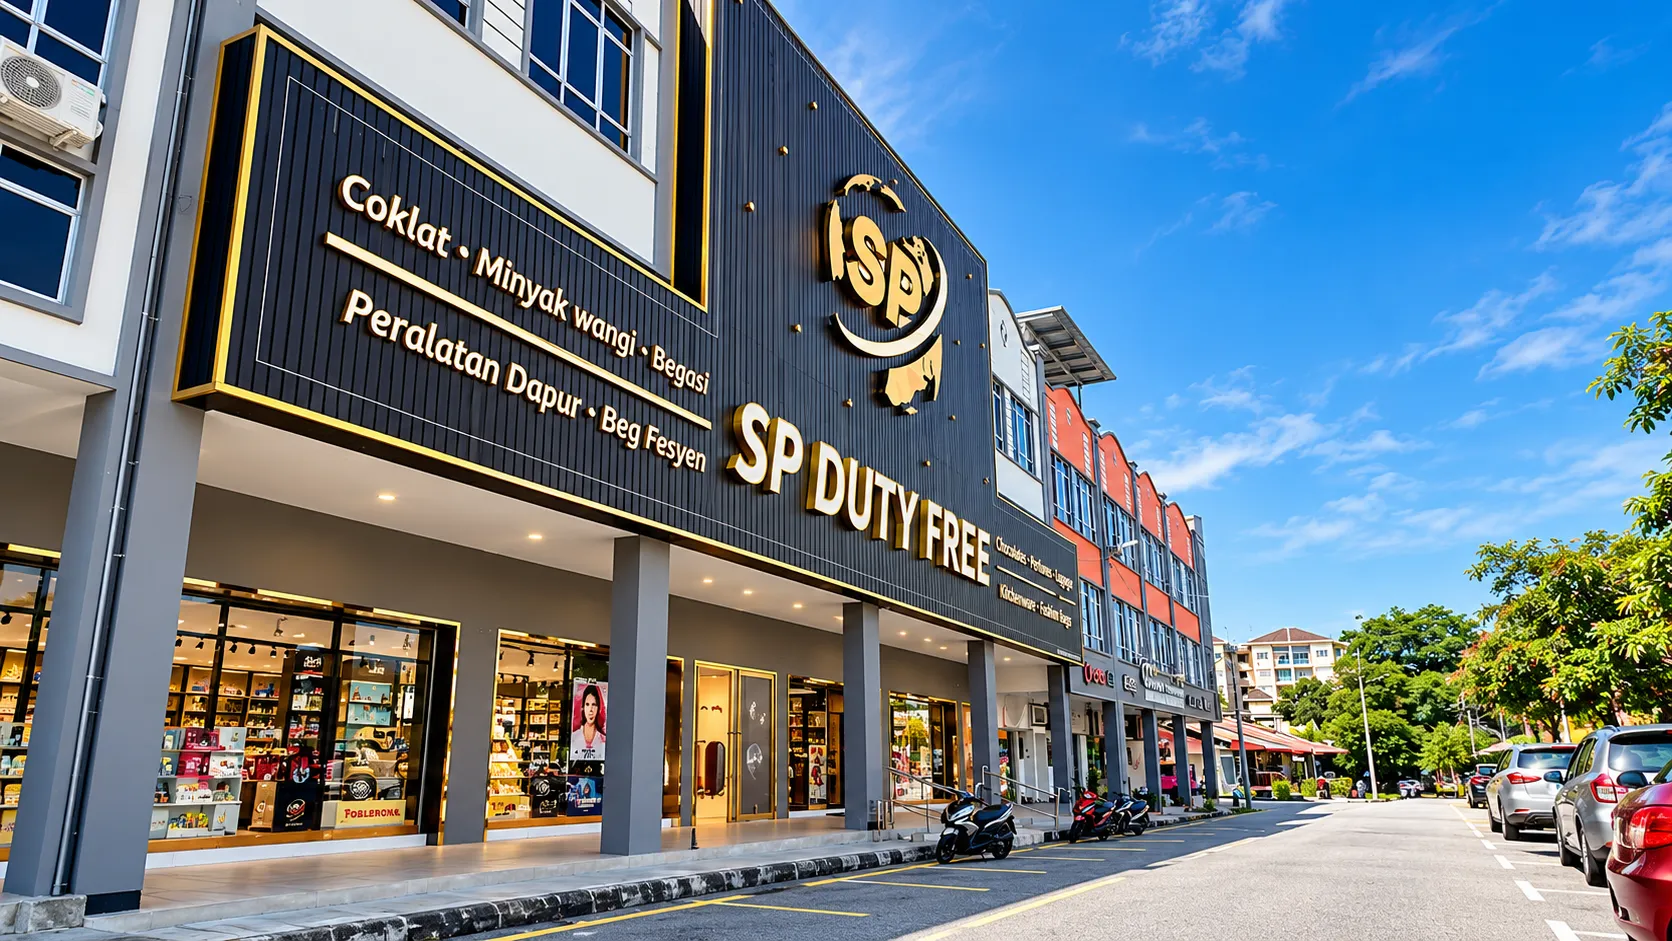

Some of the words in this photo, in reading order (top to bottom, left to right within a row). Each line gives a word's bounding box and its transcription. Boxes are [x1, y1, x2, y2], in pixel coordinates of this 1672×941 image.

[338, 174, 452, 258] Coklat
[472, 247, 569, 322] Minyak
[573, 303, 638, 359] wangi
[651, 343, 711, 396] Begasi
[844, 214, 923, 328] SP
[340, 288, 500, 386] Peralatan
[503, 361, 583, 419] Dapur
[600, 404, 642, 450] Beg
[643, 424, 707, 473] Fesyen
[726, 402, 804, 494] SP
[806, 440, 920, 550] DUTY
[919, 499, 991, 586] FREE
